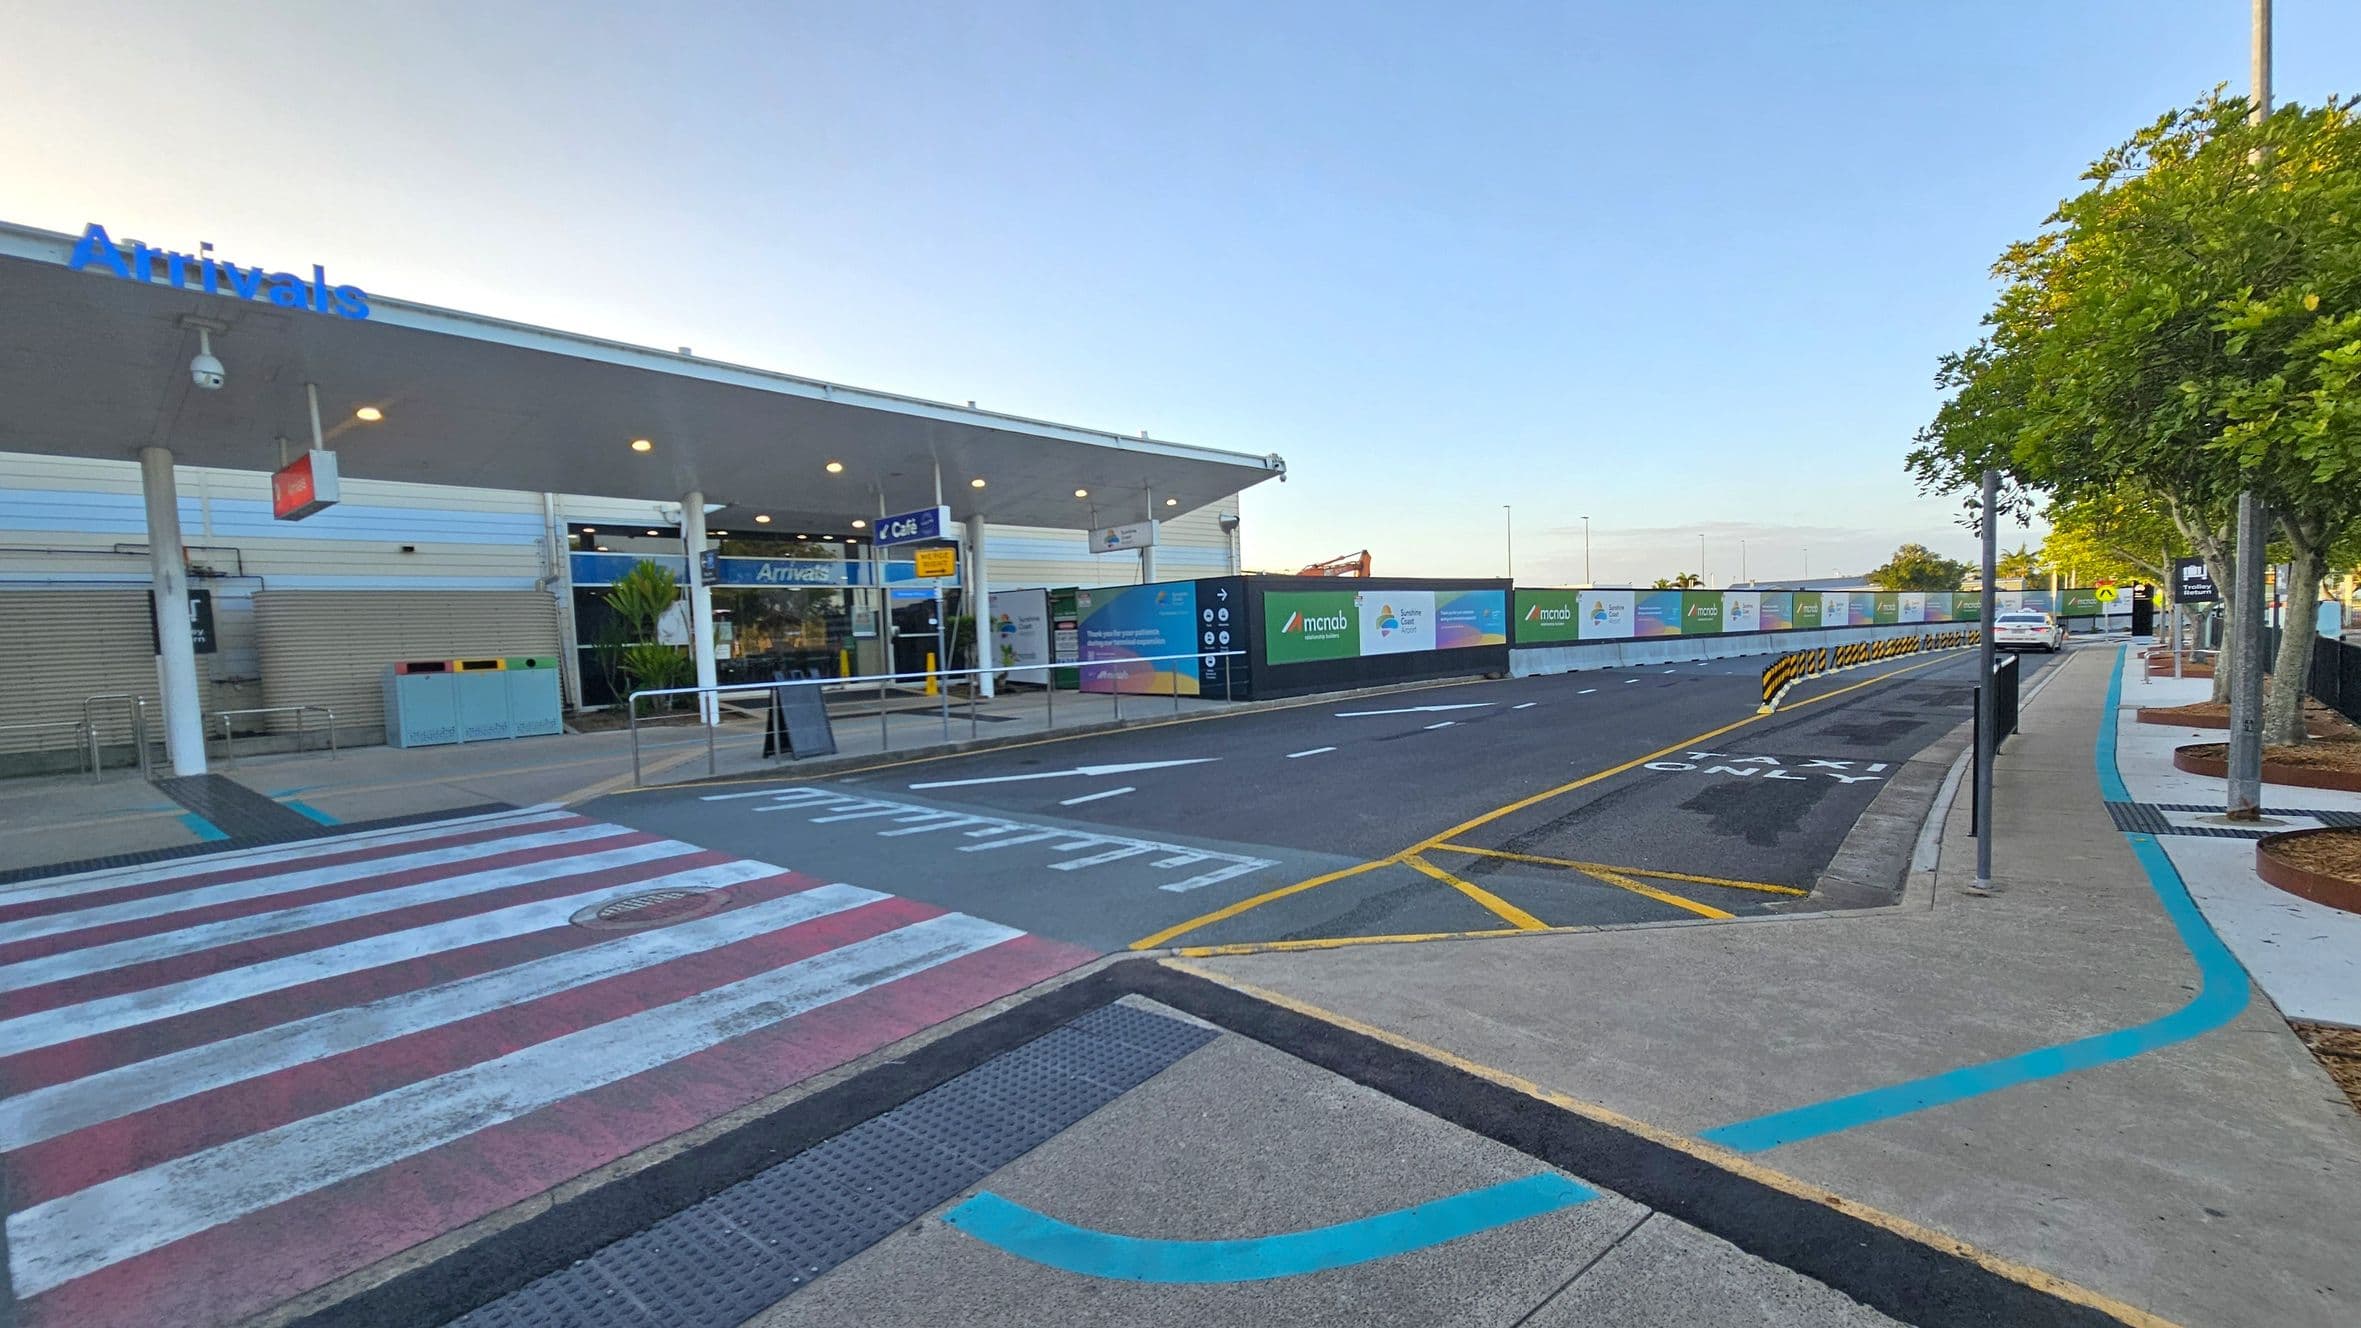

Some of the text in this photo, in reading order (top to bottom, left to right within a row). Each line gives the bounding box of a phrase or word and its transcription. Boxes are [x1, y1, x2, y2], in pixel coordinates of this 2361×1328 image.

[68, 222, 370, 320] Arrivals
[891, 518, 918, 538] Café
[756, 562, 830, 582] Arrivals
[2183, 583, 2212, 591] Trolley
[1400, 608, 1422, 617] Sunshine
[1540, 604, 1571, 620] mcnab
[1697, 603, 1718, 616] mcnab
[1304, 609, 1348, 632] mcnab
[1400, 617, 1415, 626] Coast
[1686, 751, 1888, 773] TAXI
[1643, 762, 1885, 784] ONLY
